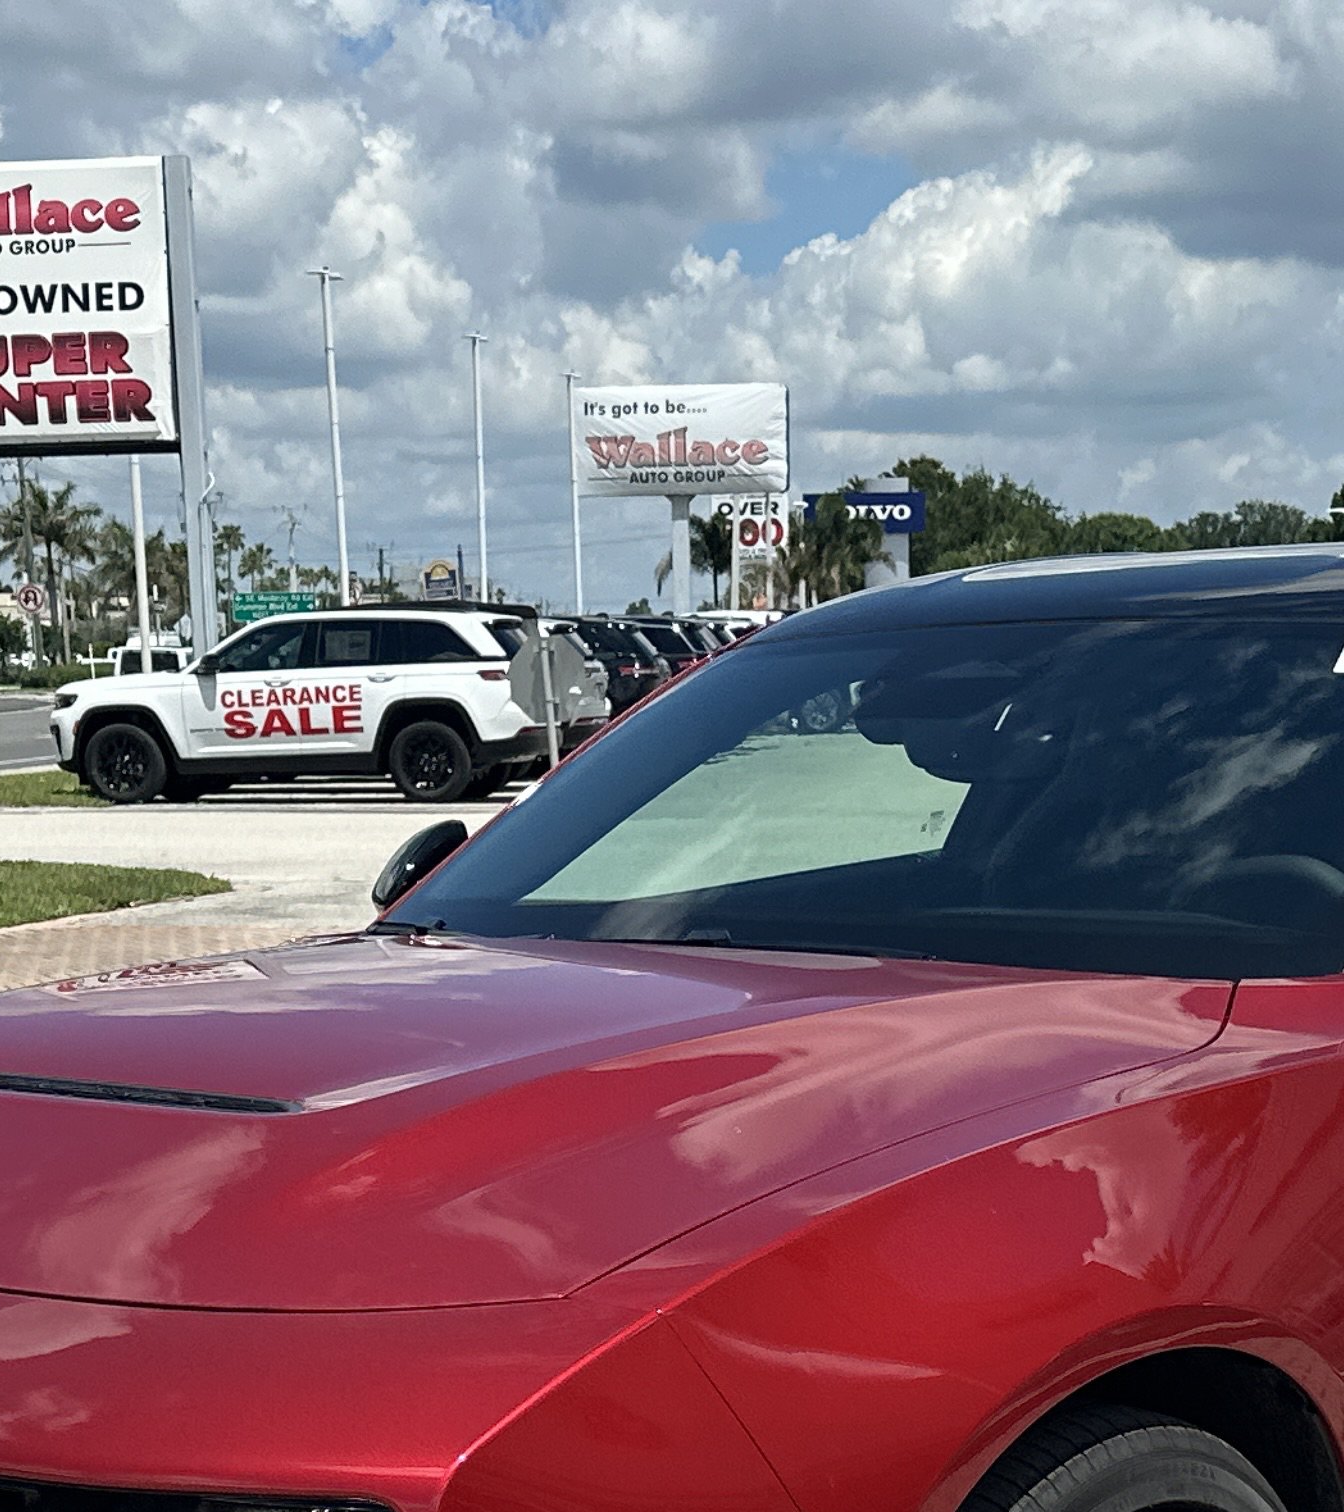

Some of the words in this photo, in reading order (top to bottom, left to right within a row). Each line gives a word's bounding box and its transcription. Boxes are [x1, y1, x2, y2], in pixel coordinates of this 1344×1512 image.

[9, 238, 76, 256] GROUP
[584, 401, 606, 416] It's
[611, 402, 638, 418] got
[644, 401, 659, 415] to
[585, 426, 769, 469] Wallace
[629, 471, 668, 484] AUTO
[673, 470, 725, 483] GROUP
[220, 684, 362, 709] CLEARANCE
[223, 704, 364, 739] SALE
